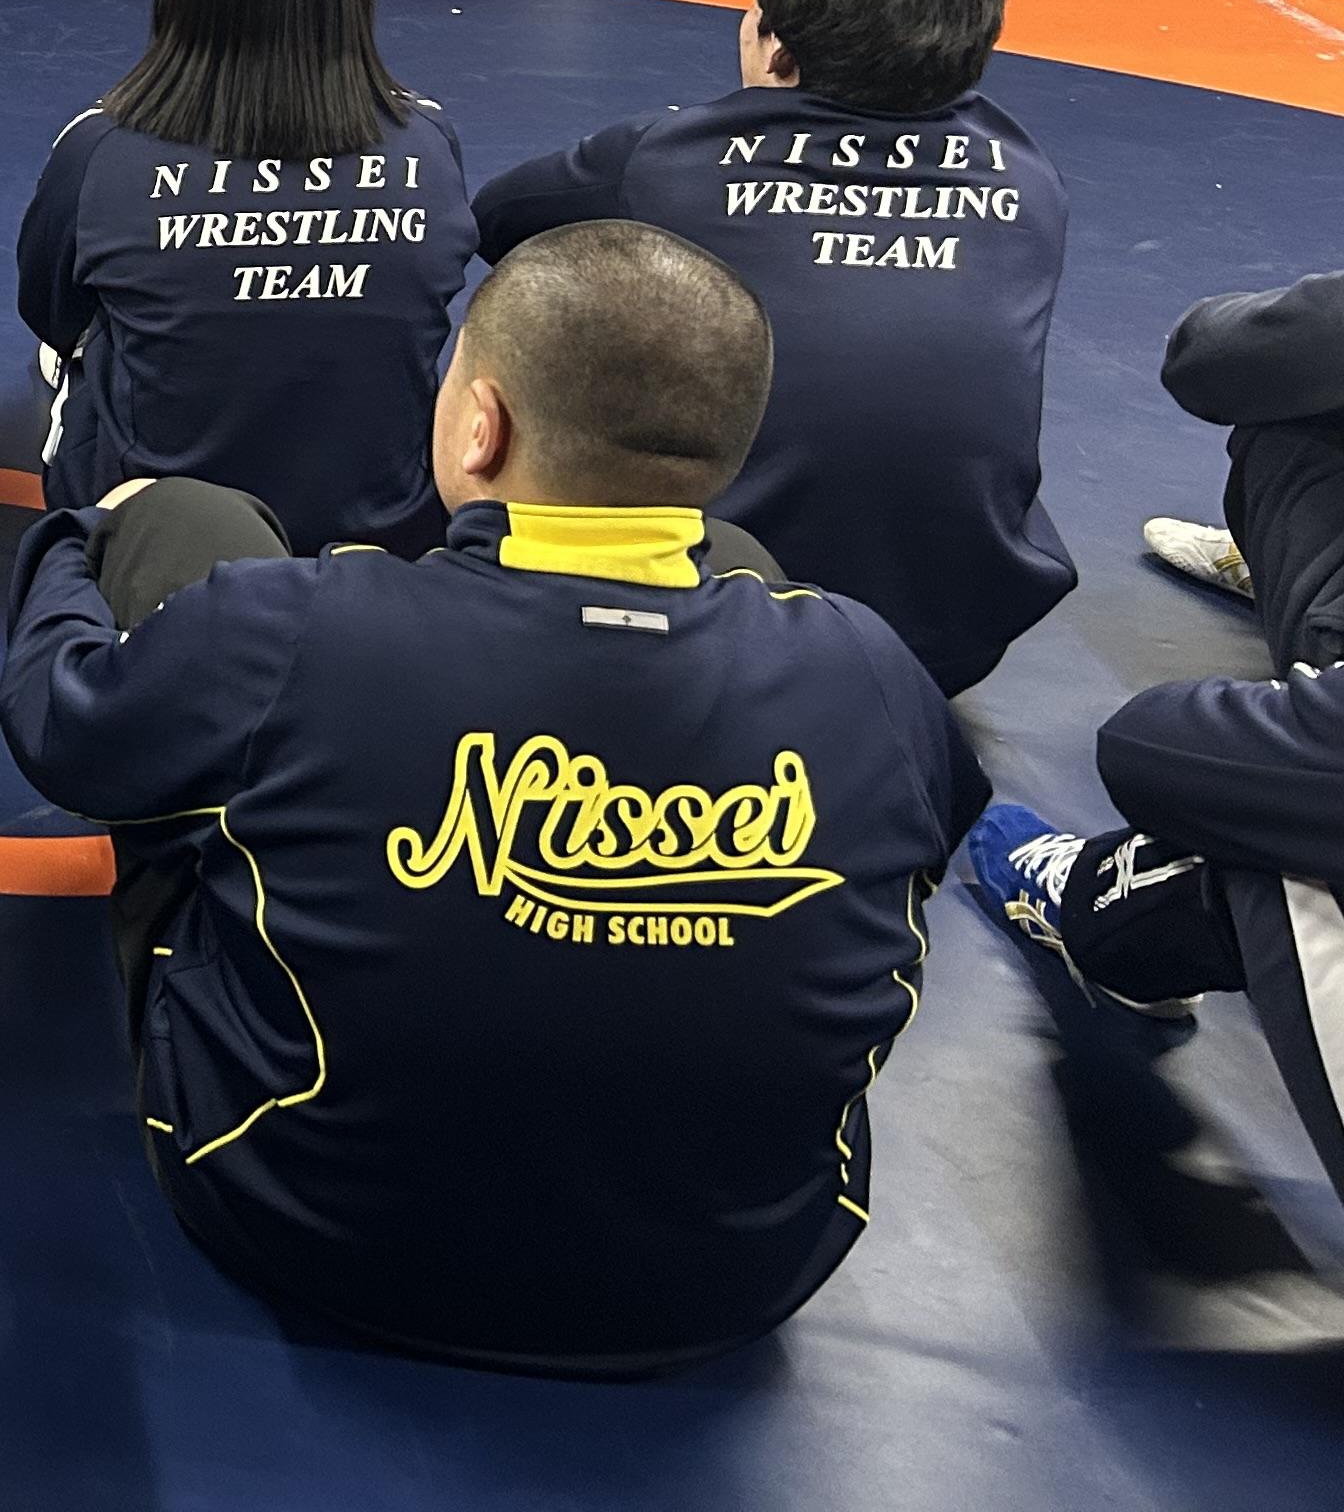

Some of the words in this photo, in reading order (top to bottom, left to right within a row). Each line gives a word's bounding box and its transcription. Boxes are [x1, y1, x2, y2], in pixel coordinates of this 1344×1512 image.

[719, 133, 1005, 170] NISSEI
[150, 155, 419, 198] NISSEI
[726, 181, 1019, 220] WRESTLING
[158, 208, 425, 249] WRESTLING
[812, 232, 960, 269] TEAM
[233, 264, 371, 300] TEAM
[387, 732, 816, 896] Nissei
[505, 895, 594, 944] HIGH
[608, 916, 734, 946] SCHOOL
